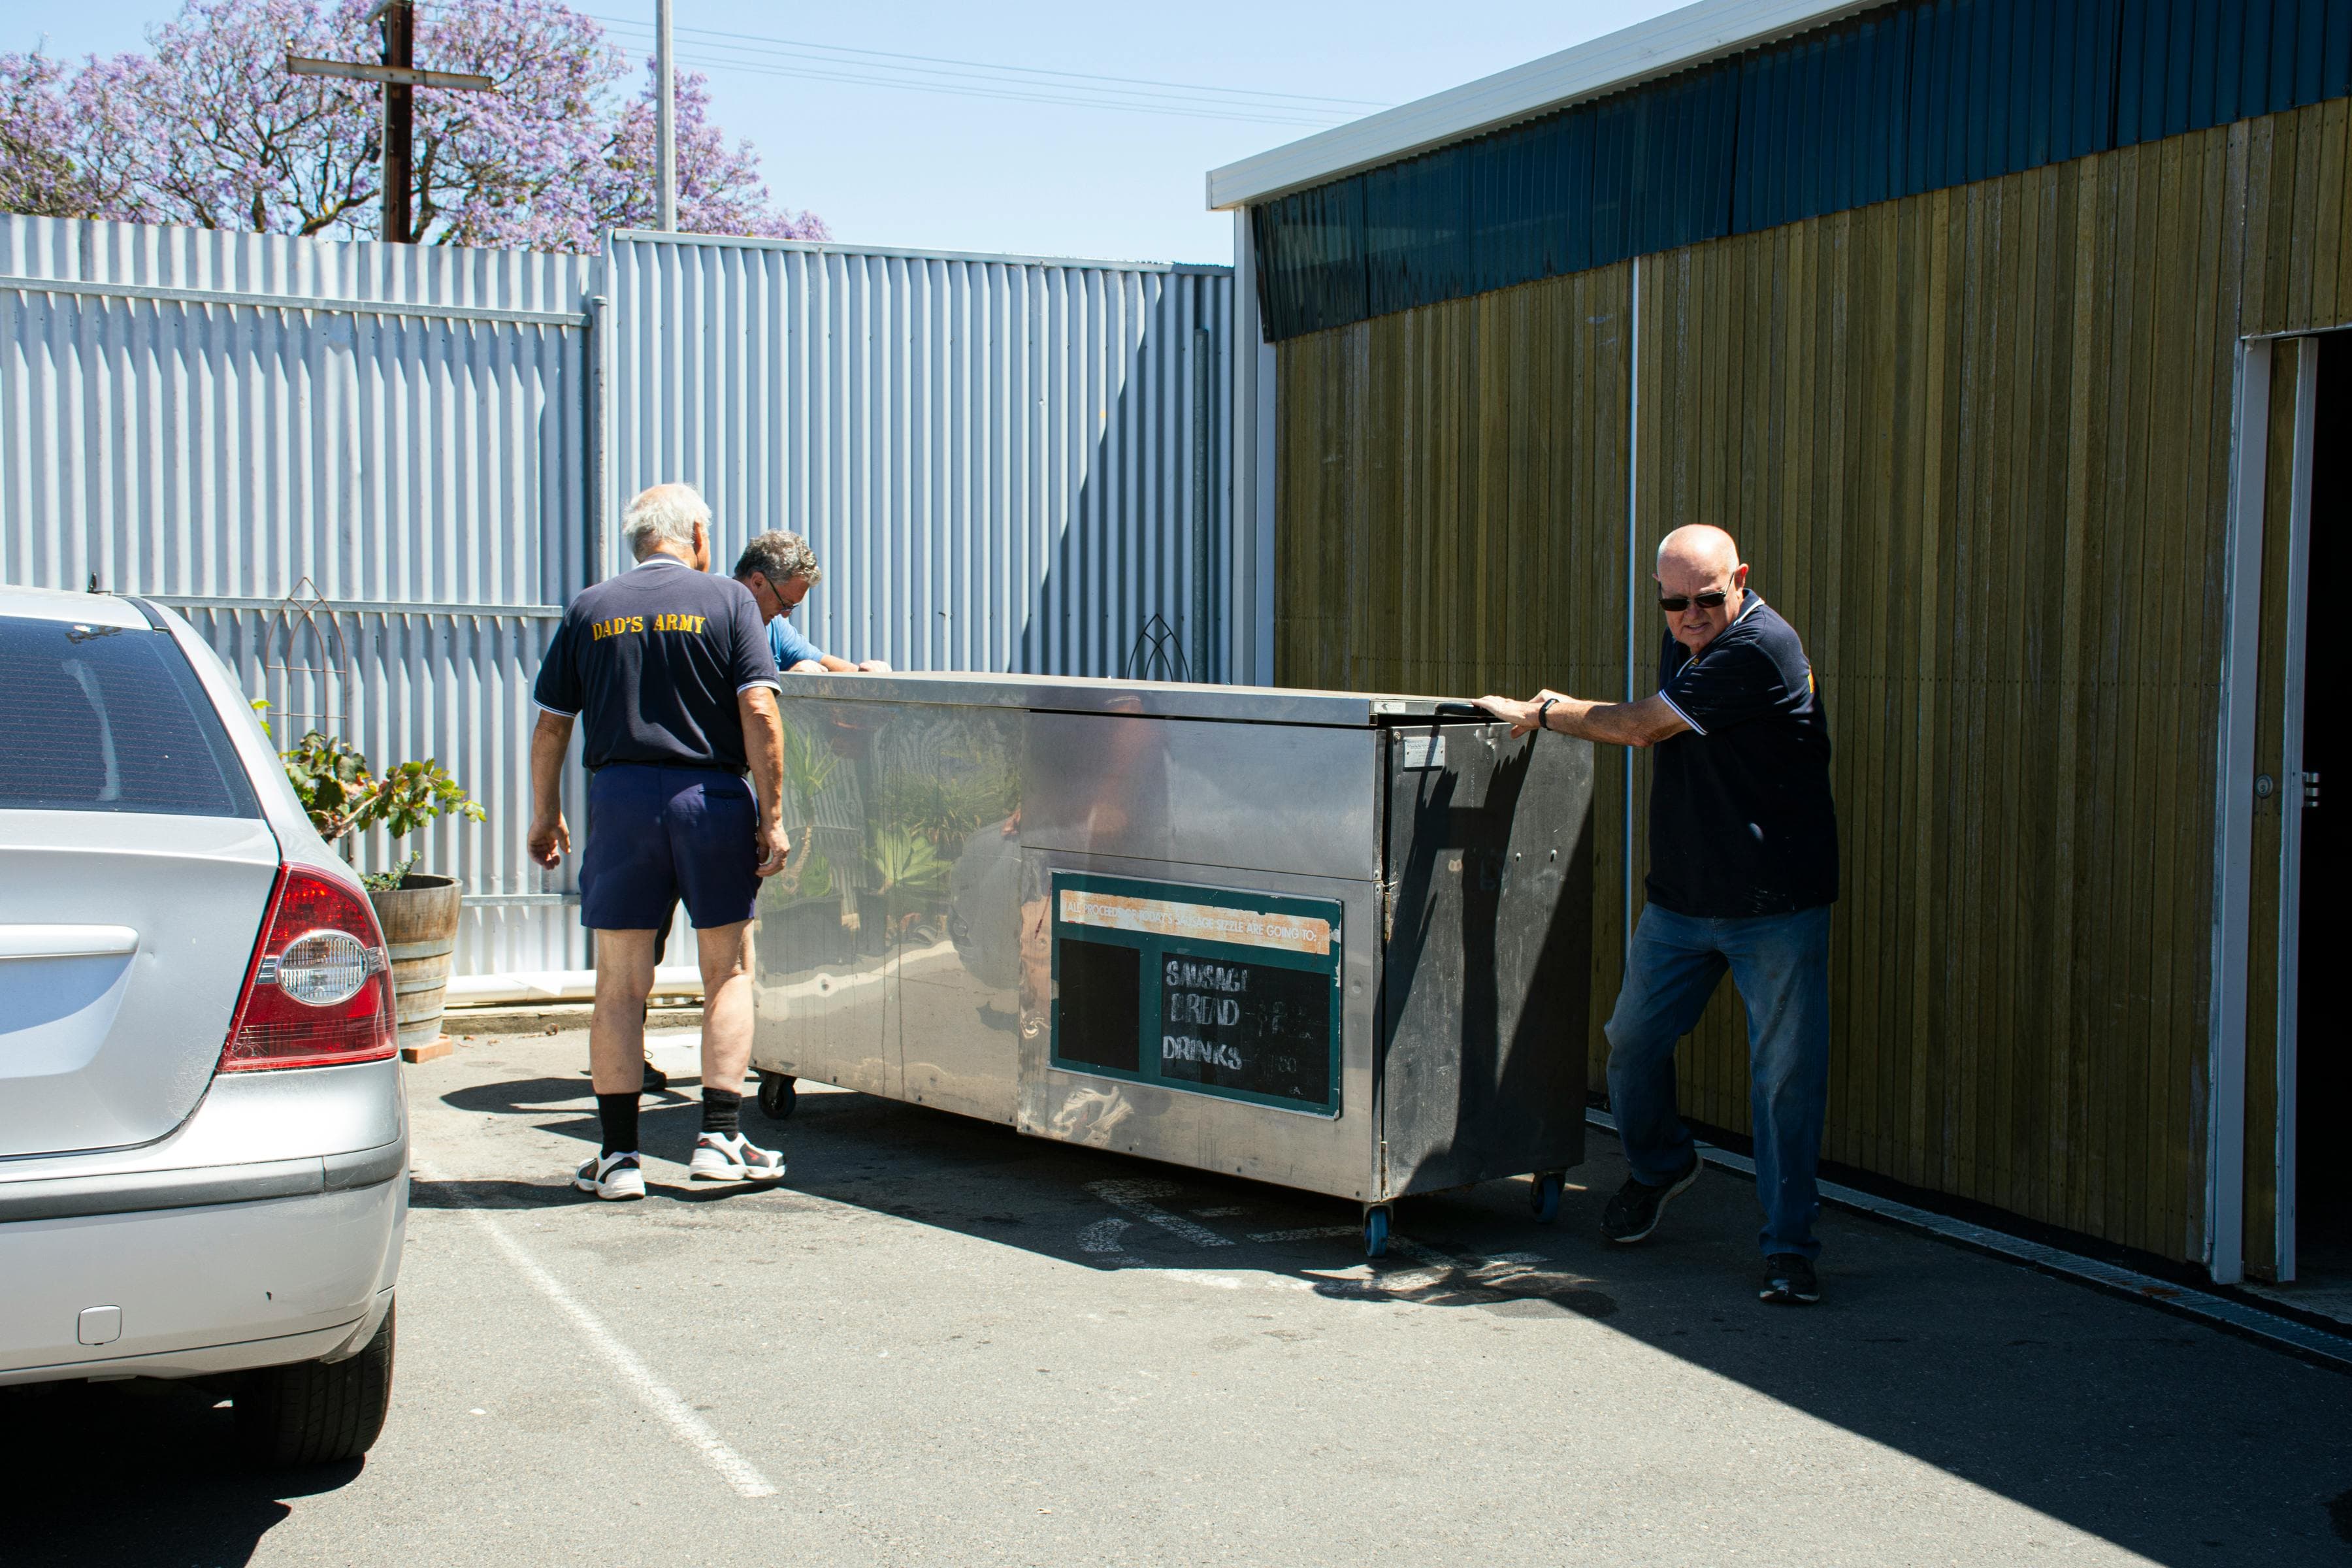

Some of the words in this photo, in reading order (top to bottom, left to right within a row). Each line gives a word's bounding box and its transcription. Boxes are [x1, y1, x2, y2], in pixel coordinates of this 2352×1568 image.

[592, 616, 644, 641] DAD'S
[653, 613, 706, 634] ARMY
[1068, 903, 1081, 913] ALL
[1175, 915, 1213, 928] SAUSAGE
[1217, 919, 1244, 932] SIZZLE
[1246, 922, 1264, 936] ARE
[1266, 925, 1299, 939] GOING
[1301, 930, 1317, 941] TO:
[1162, 1036, 1243, 1070] DRINKS
